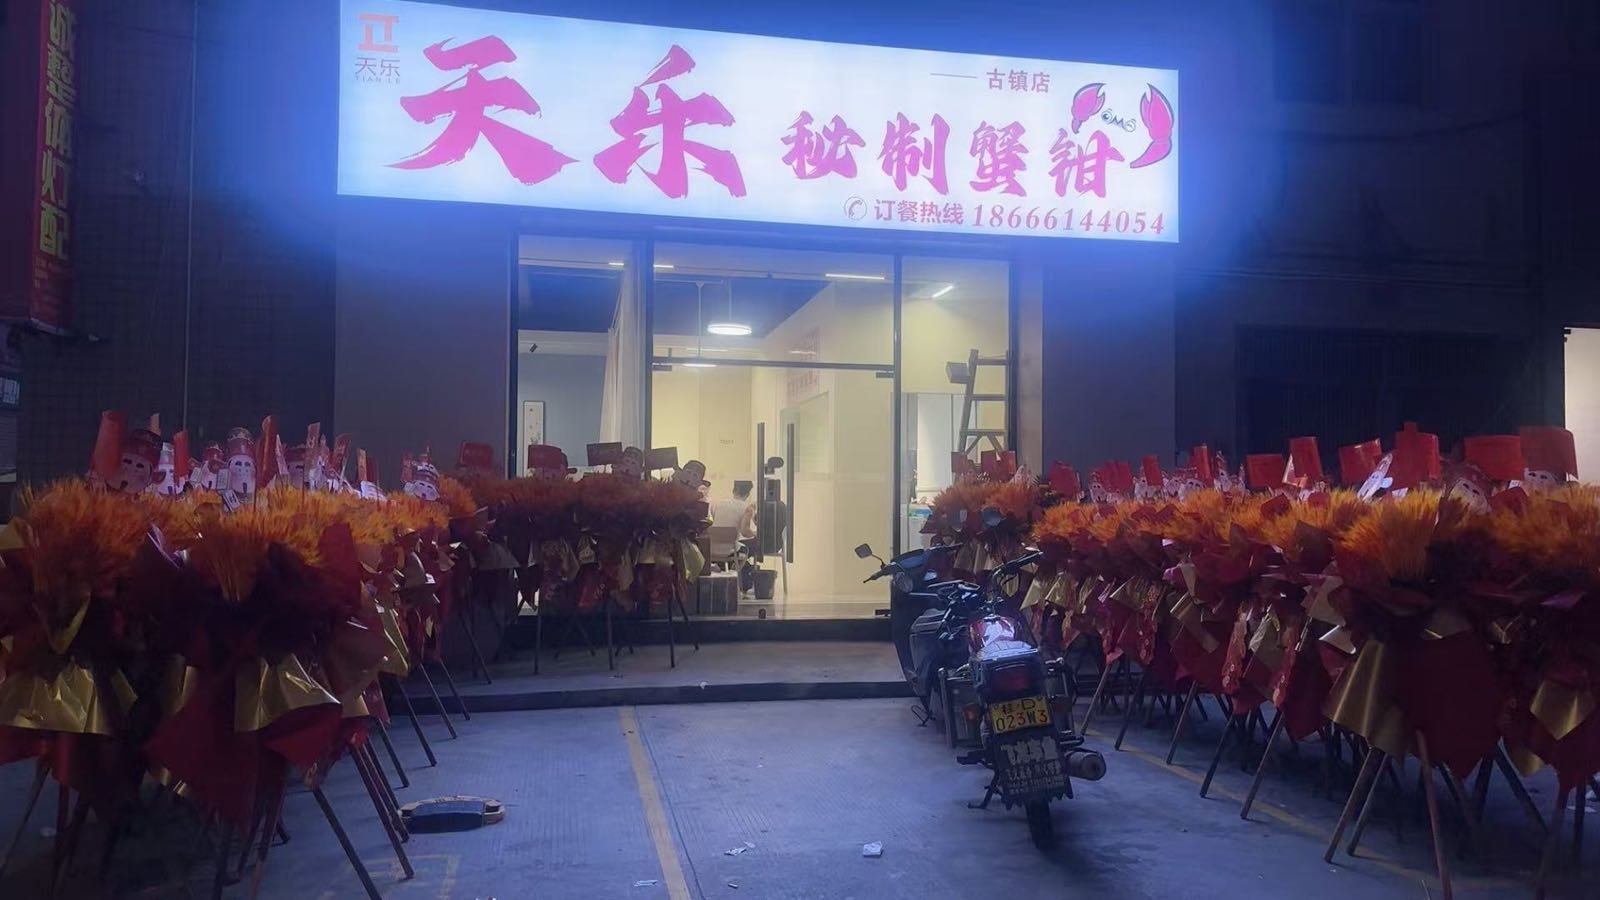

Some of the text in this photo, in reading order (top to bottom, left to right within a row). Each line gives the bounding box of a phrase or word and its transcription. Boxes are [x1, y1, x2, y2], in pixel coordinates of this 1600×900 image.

[355, 56, 401, 77] 天乐
[354, 75, 382, 83] TIAN
[986, 68, 1050, 93] 古镇店
[385, 35, 1126, 199] 天乐 秘制蟹钳
[873, 199, 1165, 234] 订餐热线 18666144054
[996, 710, 1048, 731] 023W3
